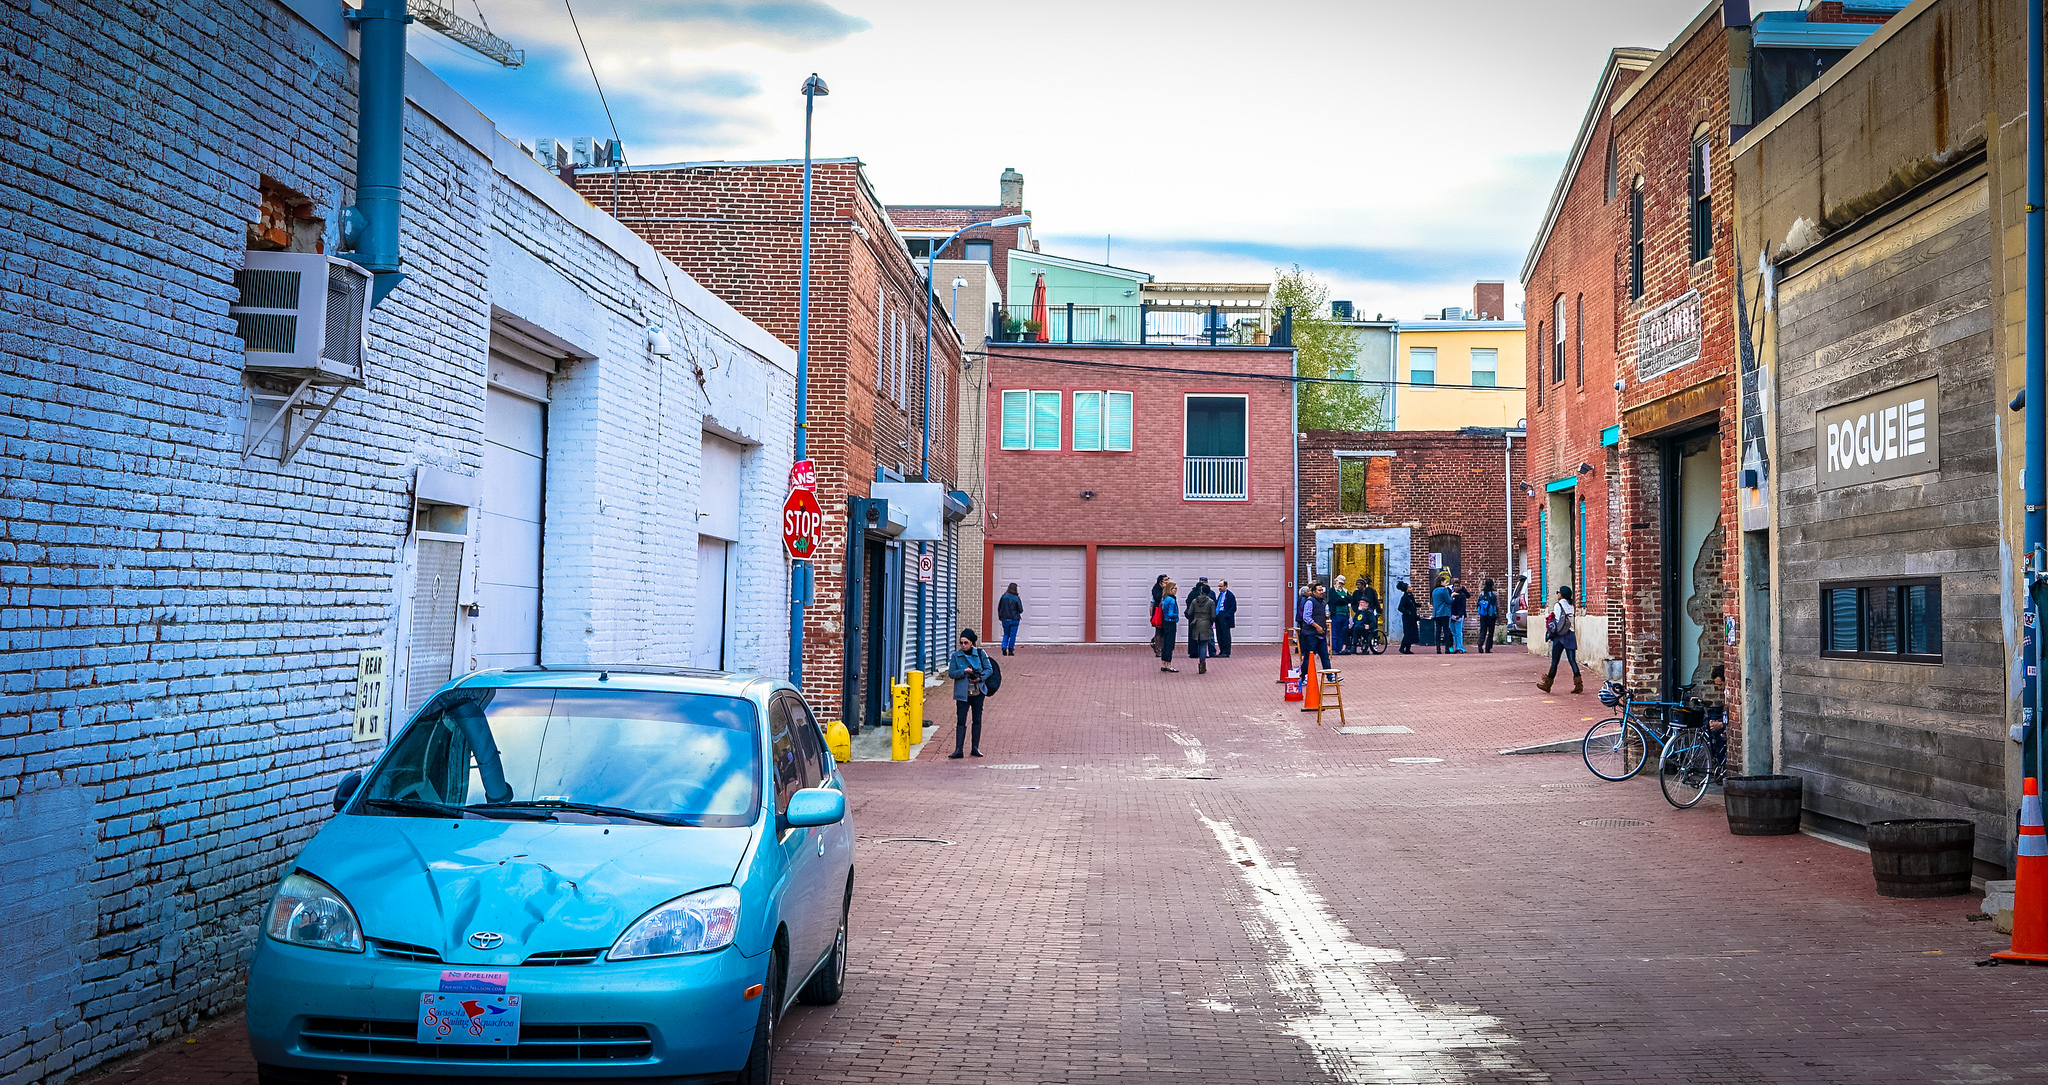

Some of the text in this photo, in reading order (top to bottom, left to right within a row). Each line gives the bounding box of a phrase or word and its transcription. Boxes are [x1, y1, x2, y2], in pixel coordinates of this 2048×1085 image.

[1651, 304, 1697, 349] COLOMBE
[785, 509, 820, 538] STOP
[364, 656, 382, 675] REAR
[369, 715, 379, 733] ST
[423, 1007, 466, 1026] Sarasota
[437, 1017, 515, 1036] Sailing Squadron
